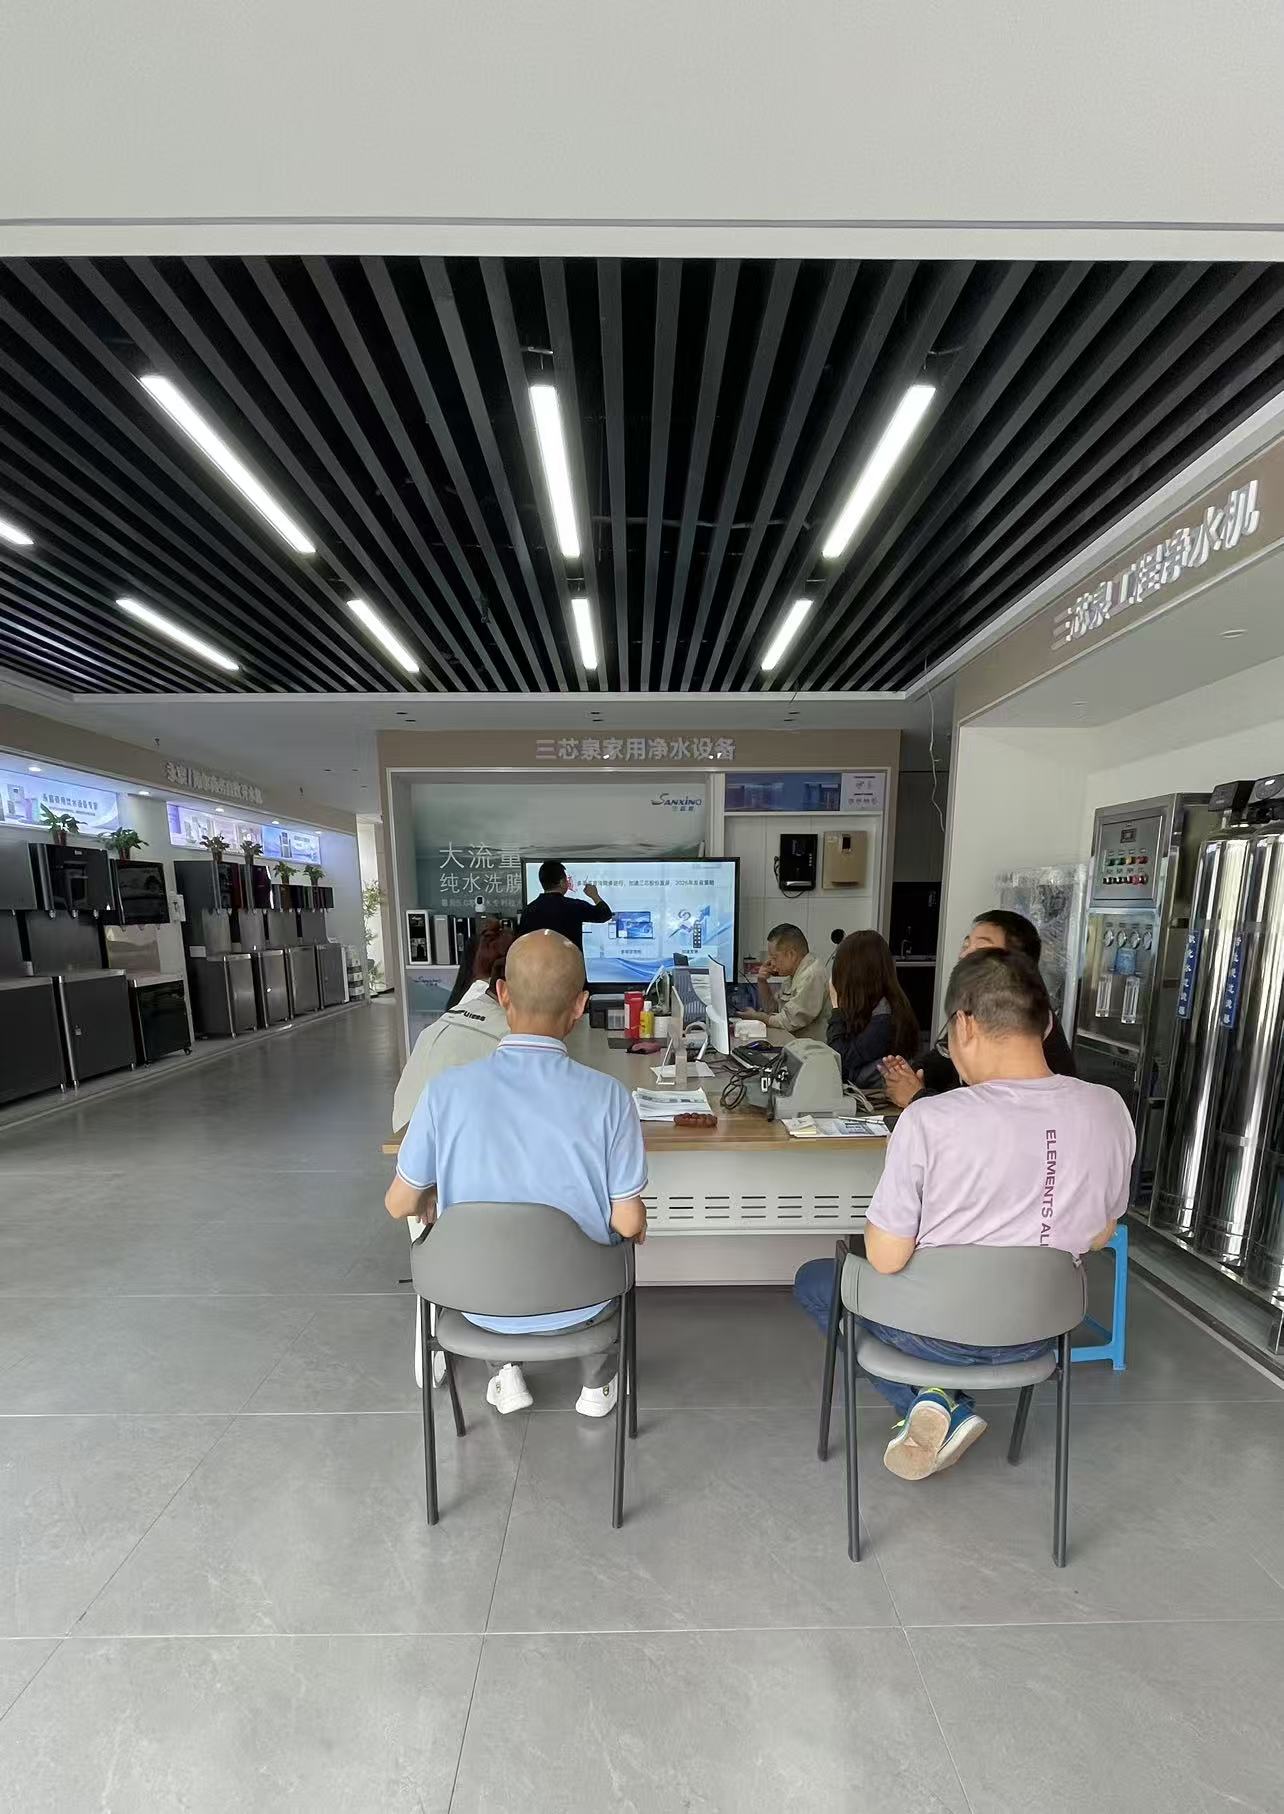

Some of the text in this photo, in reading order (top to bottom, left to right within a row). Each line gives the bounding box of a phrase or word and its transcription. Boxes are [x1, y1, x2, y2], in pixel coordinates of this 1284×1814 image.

[535, 737, 736, 761] 三芯泉家用净水设备
[440, 841, 521, 869] 大流量
[440, 872, 522, 893] 纯水洗膜
[1041, 1129, 1056, 1218] ELEMENTS
